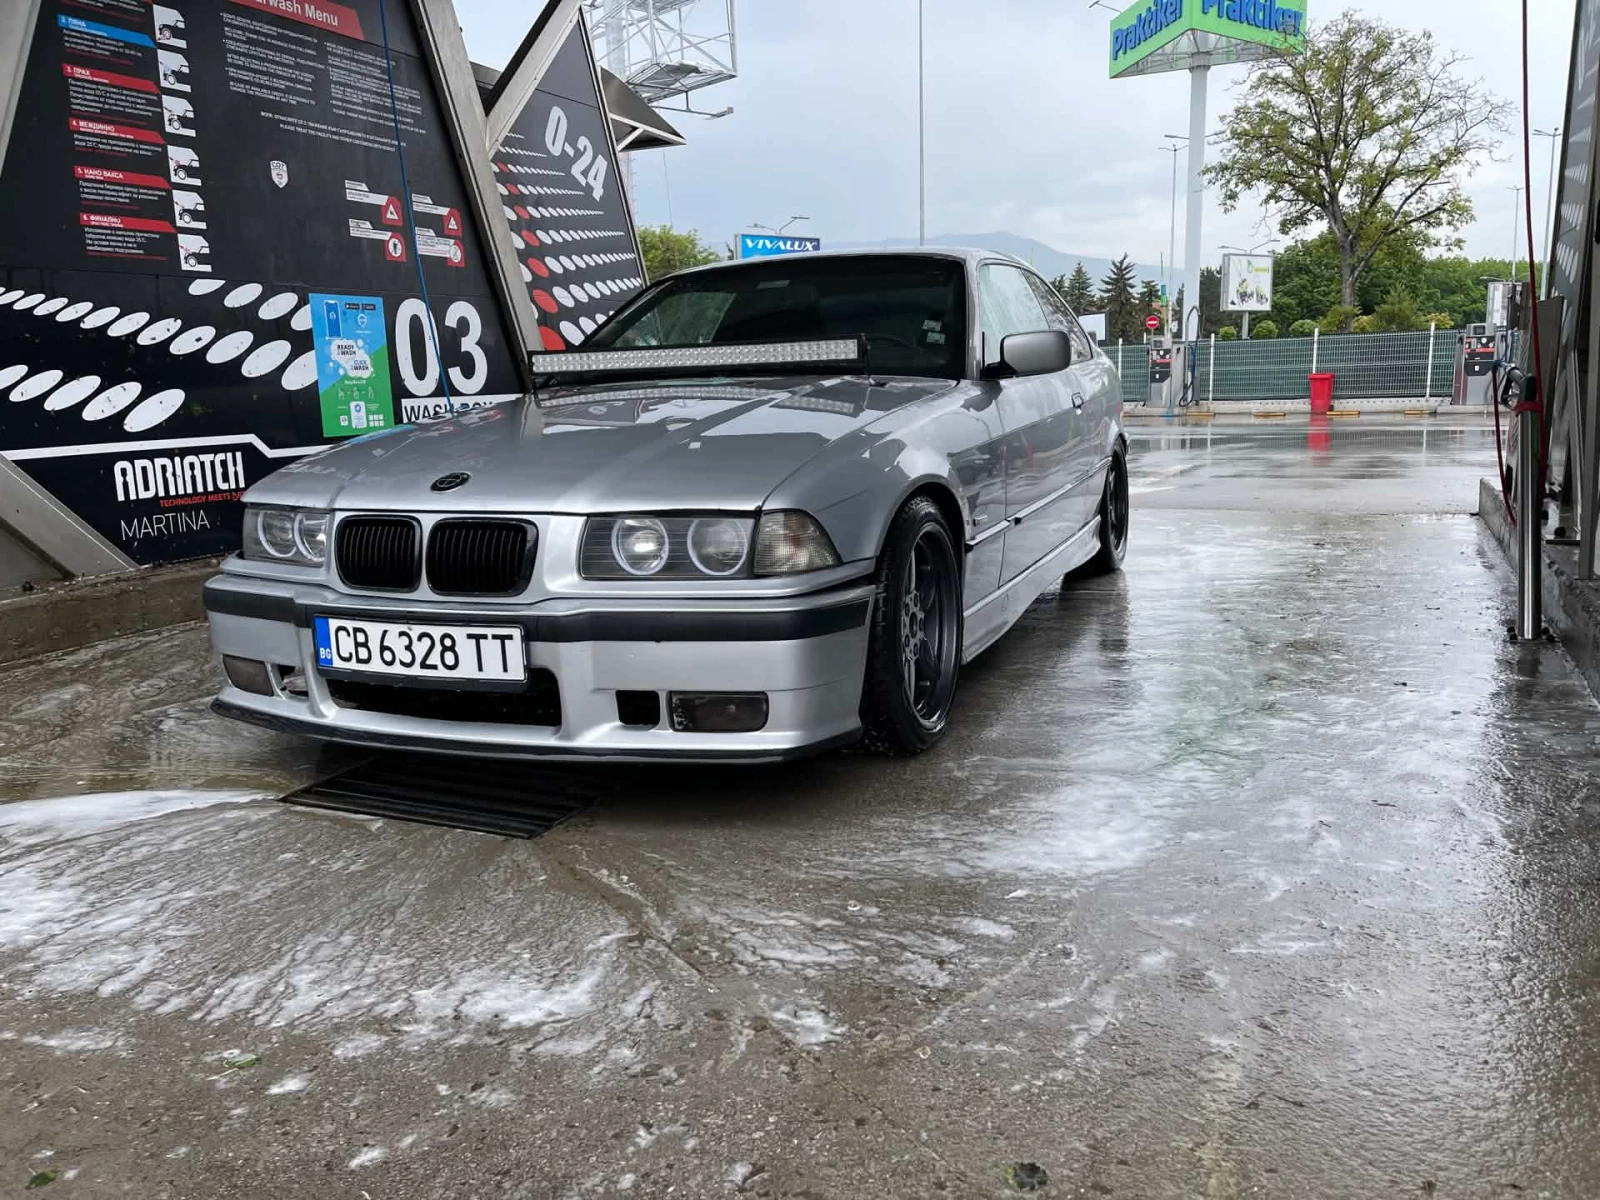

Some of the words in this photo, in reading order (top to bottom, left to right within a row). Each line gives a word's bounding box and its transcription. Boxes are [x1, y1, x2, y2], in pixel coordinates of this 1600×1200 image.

[304, 3, 338, 26] Menu
[545, 106, 608, 202] 0-24
[745, 238, 816, 251] VIVALUX
[395, 298, 488, 396] 03
[160, 495, 206, 507] TECHNOLOGY
[208, 492, 231, 502] MEETS
[120, 509, 211, 541] MARTINA
[319, 647, 332, 660] BG
[334, 625, 372, 665] CB
[379, 629, 460, 671] 6328
[466, 632, 514, 673] TT
